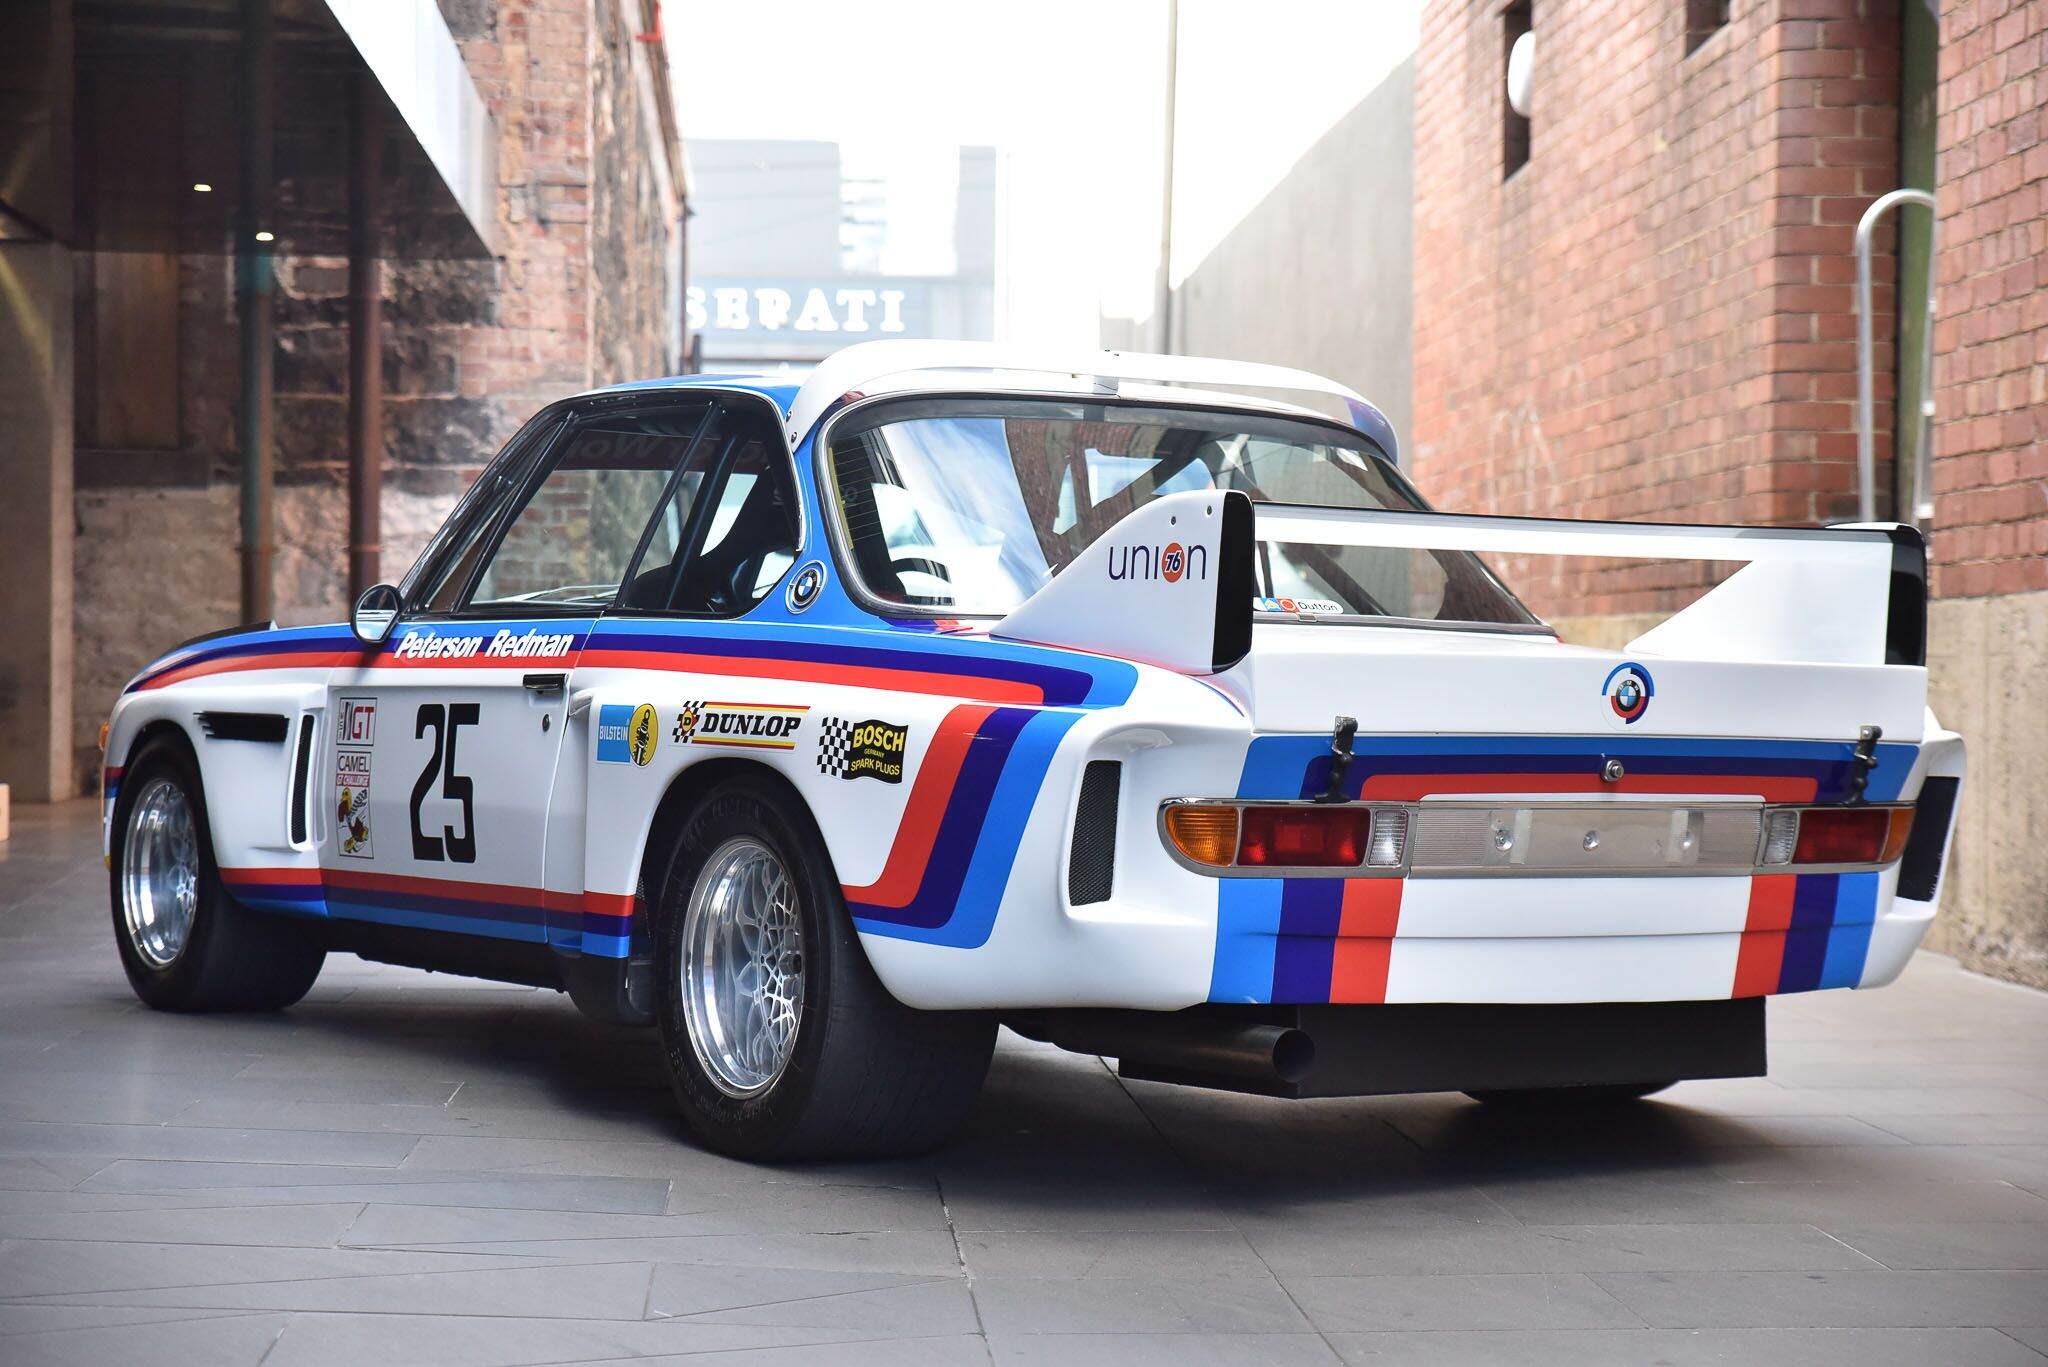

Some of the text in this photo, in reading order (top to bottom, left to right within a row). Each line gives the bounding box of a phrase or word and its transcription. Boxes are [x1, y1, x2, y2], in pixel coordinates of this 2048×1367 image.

[1298, 601, 1338, 611] Dutton
[394, 628, 575, 659] Peterson Redman
[352, 706, 375, 740] GT
[599, 725, 628, 741] BILSTEIN
[701, 713, 801, 738] DUNLOP
[853, 725, 905, 752] BOSCH
[338, 755, 370, 773] CAMEL
[850, 758, 900, 776] SPARK PLUGS
[410, 703, 481, 863] 25
